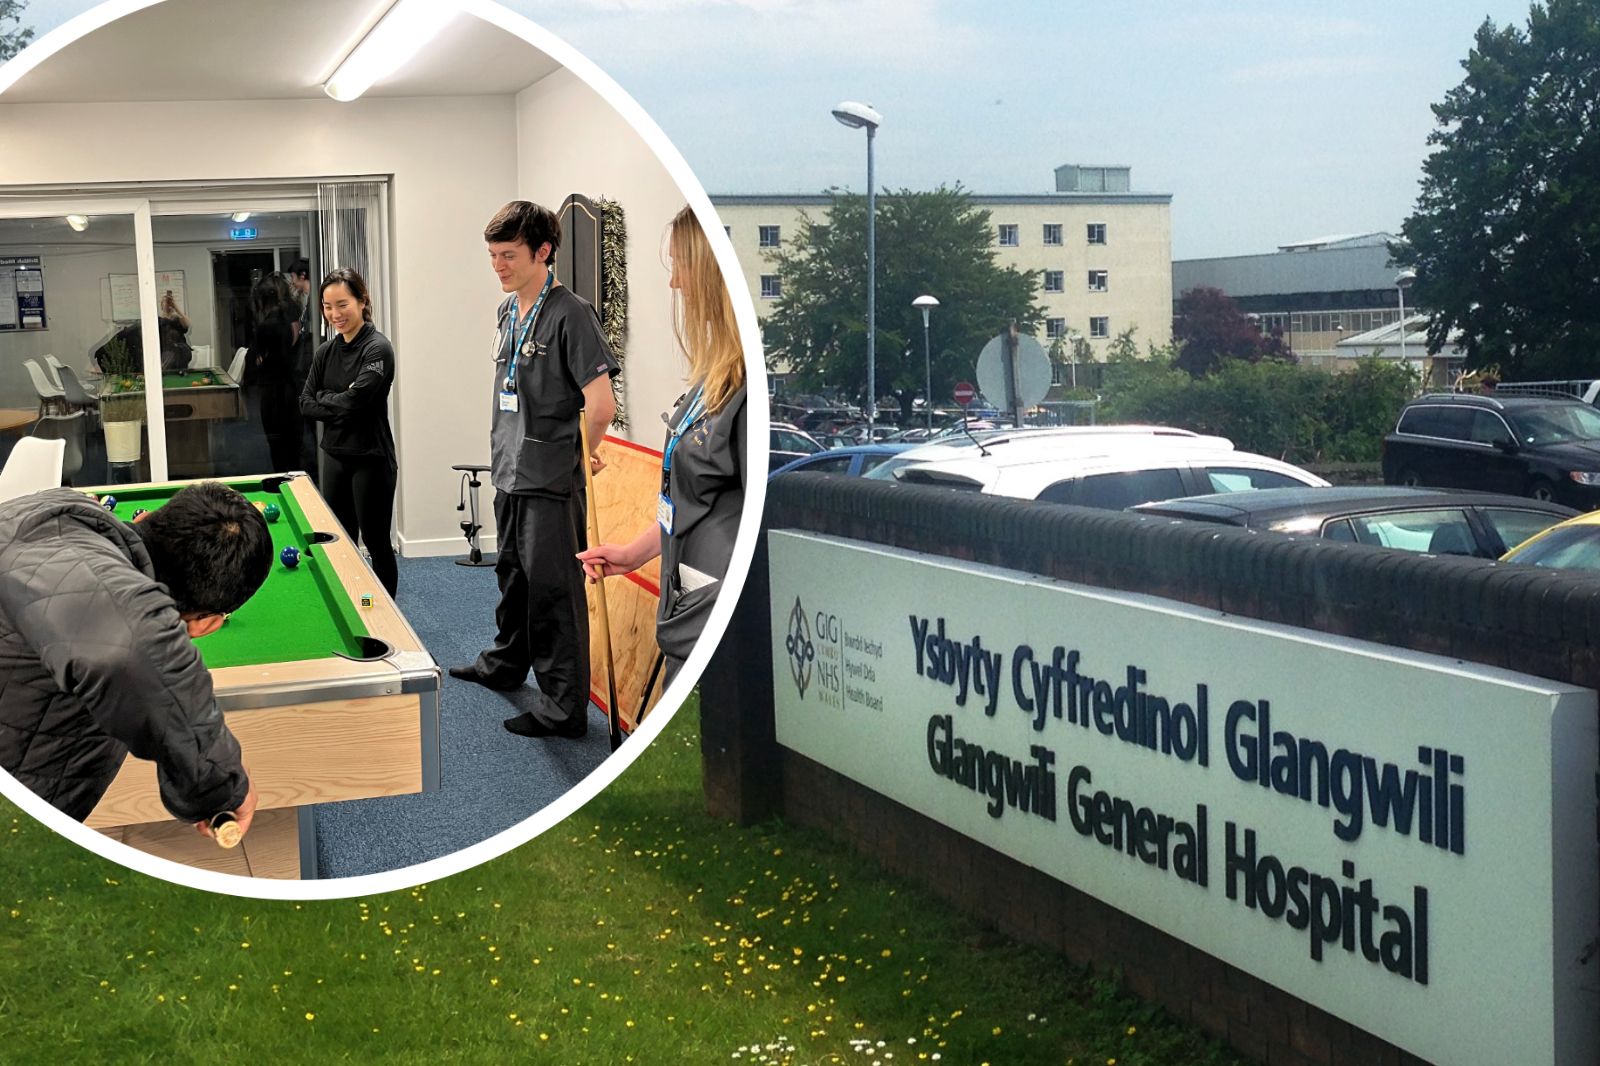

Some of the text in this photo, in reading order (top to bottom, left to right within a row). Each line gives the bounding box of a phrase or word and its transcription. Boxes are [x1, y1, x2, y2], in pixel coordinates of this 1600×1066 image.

[816, 611, 837, 643] GIG
[817, 660, 839, 693] NHS
[909, 615, 1464, 855] Ysbyty Cyffredinol Glangwili
[927, 714, 1429, 985] Glangwili General Hospital
